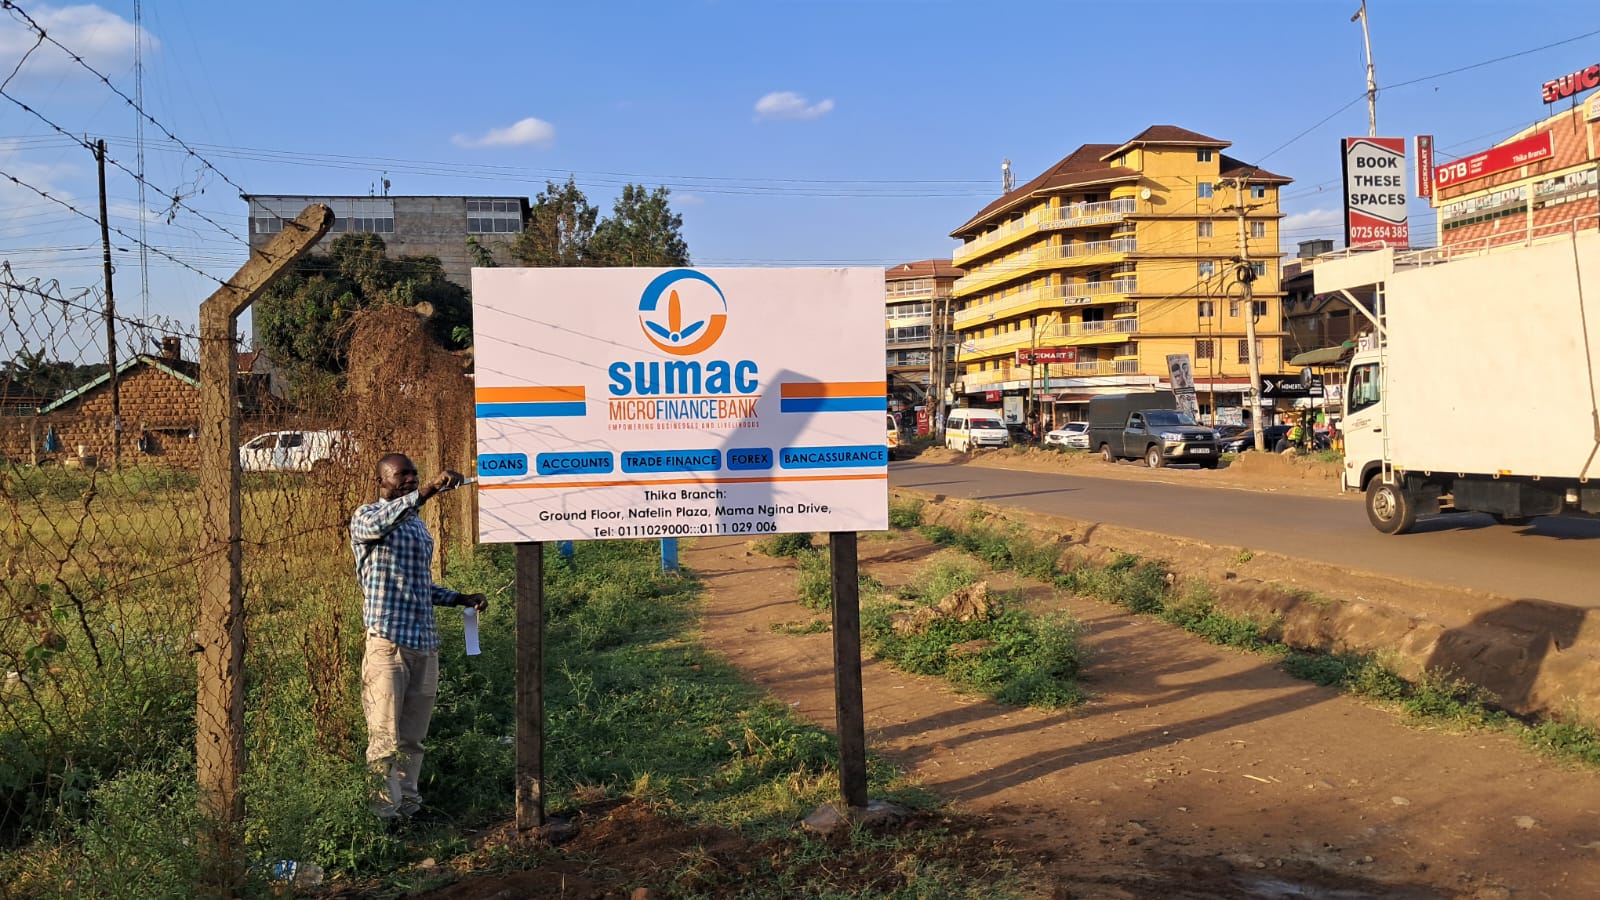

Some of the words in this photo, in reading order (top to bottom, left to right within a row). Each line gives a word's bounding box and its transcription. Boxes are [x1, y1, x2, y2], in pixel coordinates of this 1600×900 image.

[1543, 65, 1600, 102] QUIC
[1356, 156, 1398, 169] BOOK
[1439, 162, 1467, 184] DTB
[1353, 175, 1401, 187] THESE
[1350, 193, 1406, 205] SPACES
[1351, 226, 1373, 238] 0725
[1374, 226, 1391, 238] 654
[1391, 226, 1408, 238] 385
[1019, 352, 1067, 360] QCKMART
[608, 360, 759, 396] sumac
[608, 399, 759, 420] MICROFINANCEBANK
[608, 423, 654, 431] EMPOWERING
[701, 421, 715, 430] AND
[541, 457, 610, 469] ACCOUNTS
[627, 456, 662, 467] TRADE
[666, 455, 718, 466] FINANCE
[732, 453, 768, 464] FOREX
[784, 450, 884, 464] BANCASSURANCE
[482, 459, 523, 470] LOANS
[644, 490, 676, 501] Thika
[681, 489, 727, 500] Branch:
[539, 510, 587, 521] Ground
[591, 509, 624, 521] Floor,
[628, 507, 672, 519] Nafelin
[676, 506, 711, 518] Plaza,
[715, 505, 754, 516] Mama
[758, 503, 794, 517] Ngina
[797, 503, 832, 515] Drive,
[594, 526, 614, 537] Tel:
[732, 521, 752, 533] 029
[756, 521, 777, 532] 006
